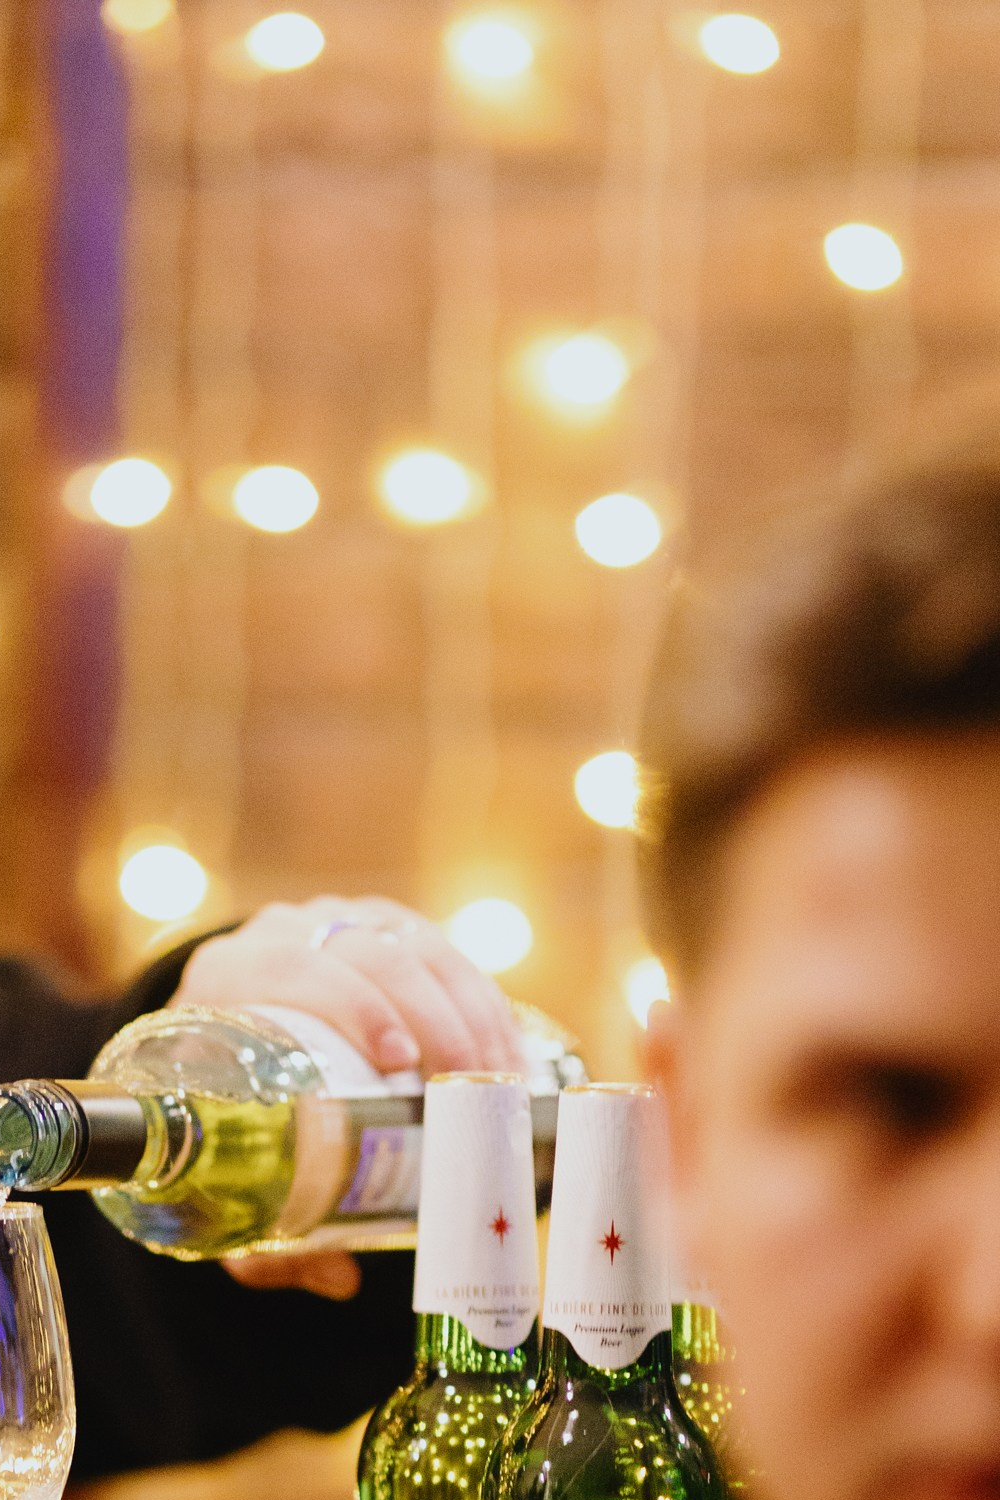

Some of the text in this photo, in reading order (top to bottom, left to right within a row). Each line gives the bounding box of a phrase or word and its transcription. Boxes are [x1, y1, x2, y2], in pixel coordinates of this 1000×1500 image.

[600, 1302, 626, 1316] FINE
[633, 1302, 645, 1317] DE
[574, 1321, 646, 1339] Premium Lager
[600, 1337, 622, 1348] Beer
